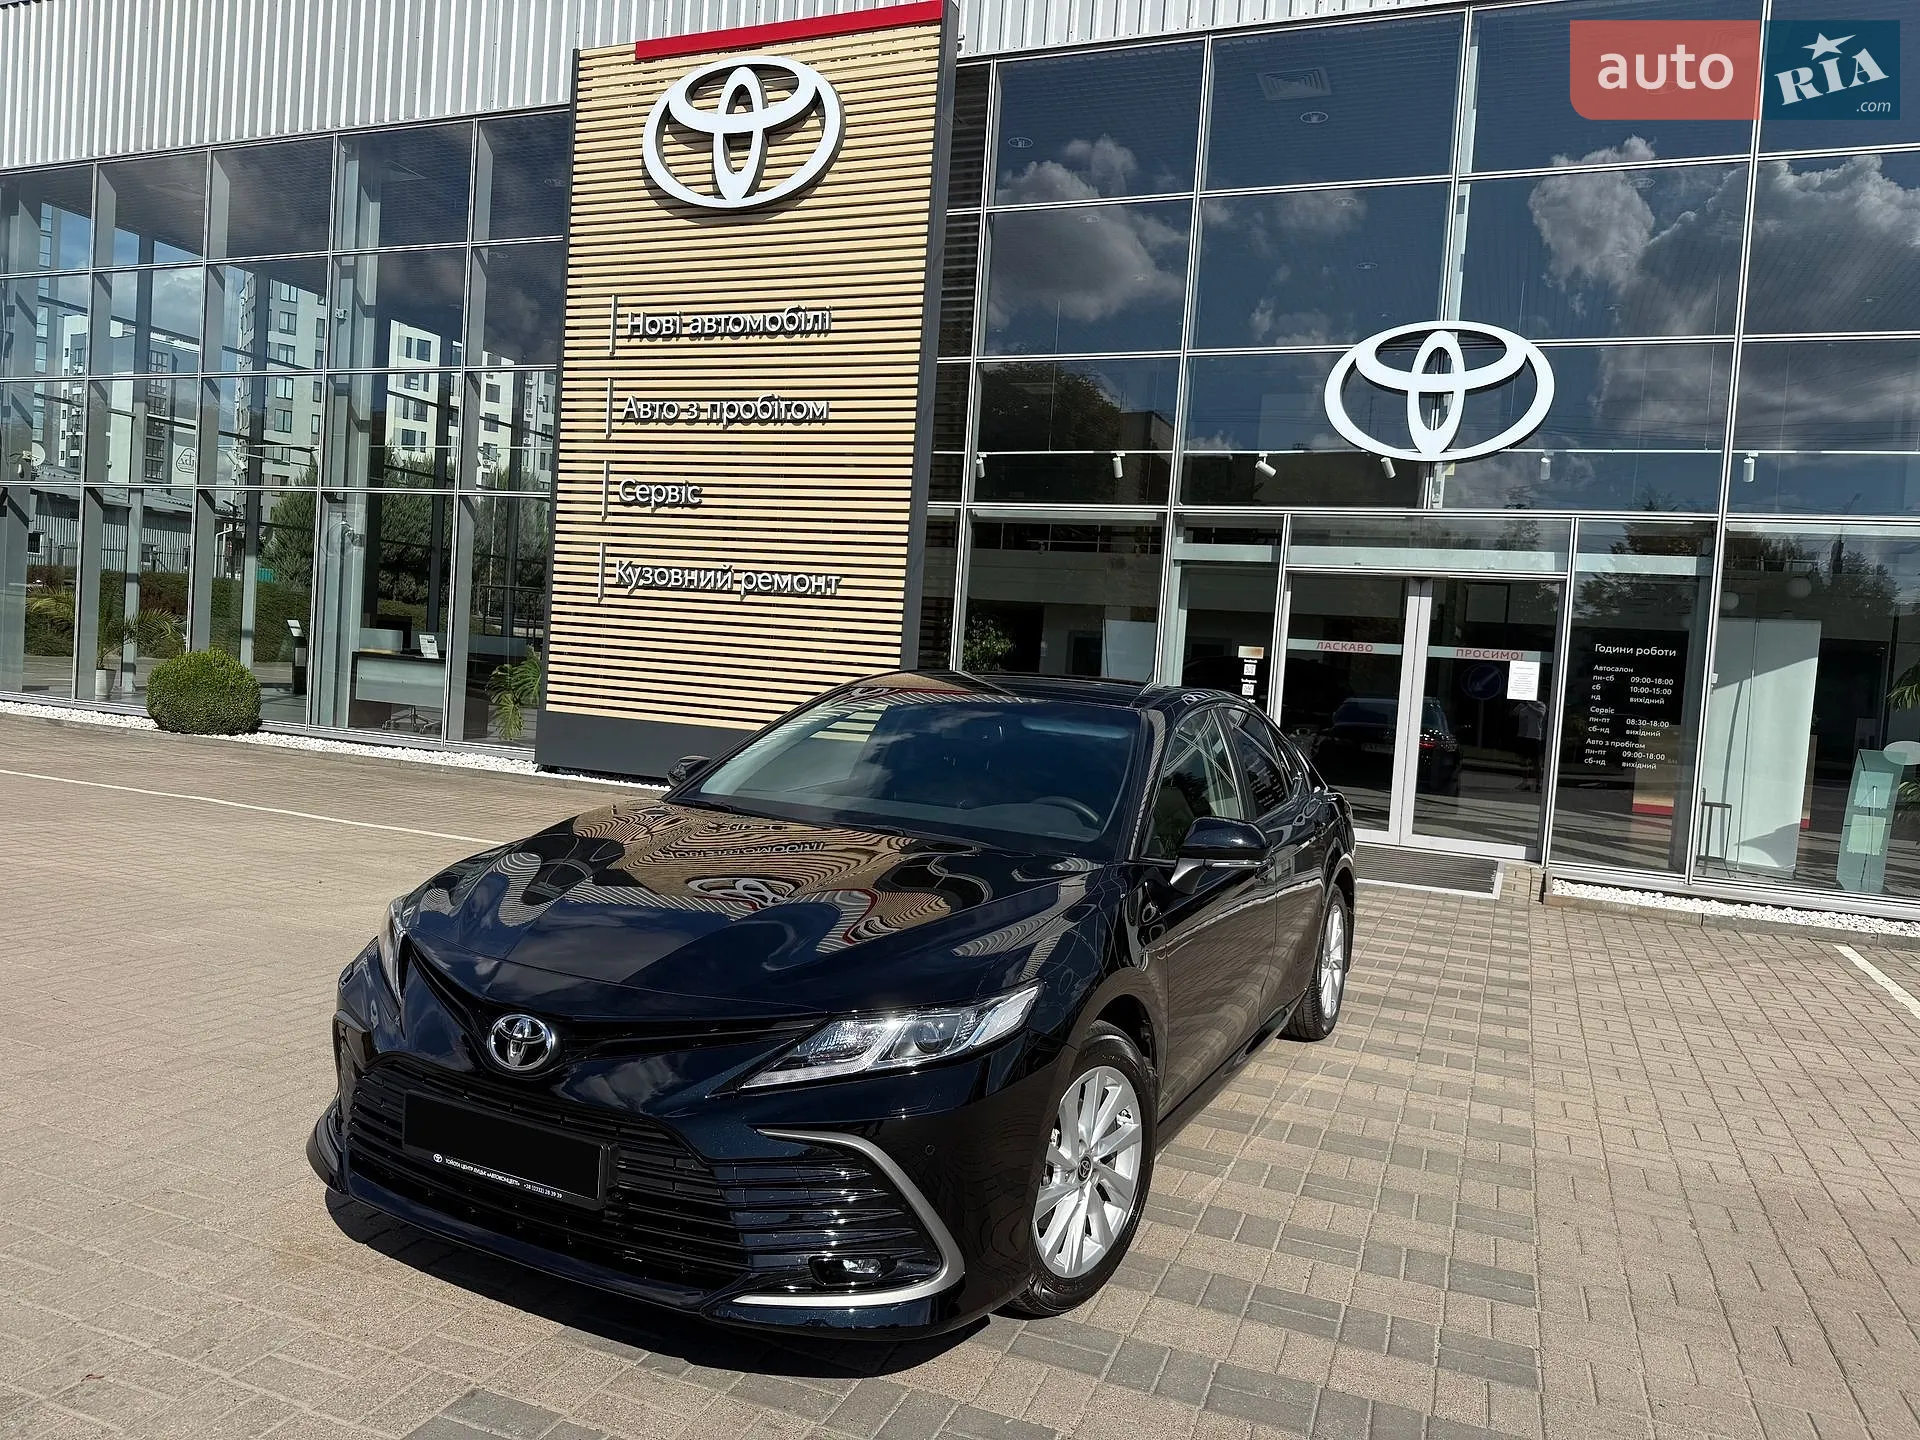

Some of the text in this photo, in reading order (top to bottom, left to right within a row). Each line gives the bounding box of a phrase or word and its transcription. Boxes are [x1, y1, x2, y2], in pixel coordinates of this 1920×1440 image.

[628, 305, 832, 336] Нові автомобілі
[622, 394, 830, 428] Авто з пробігом
[619, 478, 702, 509] Сервіс
[616, 560, 840, 599] Кузовний ремонт
[1316, 641, 1524, 661] ЛАСКАВО ПРОСИМО!
[1594, 643, 1677, 657] Години роботи
[1593, 664, 1634, 673] Автосалон
[1630, 676, 1674, 686] 09:00-18:00
[1591, 683, 1672, 695] сб 10:00-15:00
[1629, 696, 1665, 705] вихідний
[1590, 705, 1615, 715] Сервіс
[1625, 718, 1670, 728] 08:30-18:00
[1588, 725, 1661, 737] сб-нд вихідний
[1585, 738, 1604, 746] Авто
[1610, 740, 1646, 749] пробігом
[1622, 750, 1666, 761] 09:00-18:00
[1584, 757, 1606, 766] сб-нд
[1621, 761, 1657, 770] вихідний
